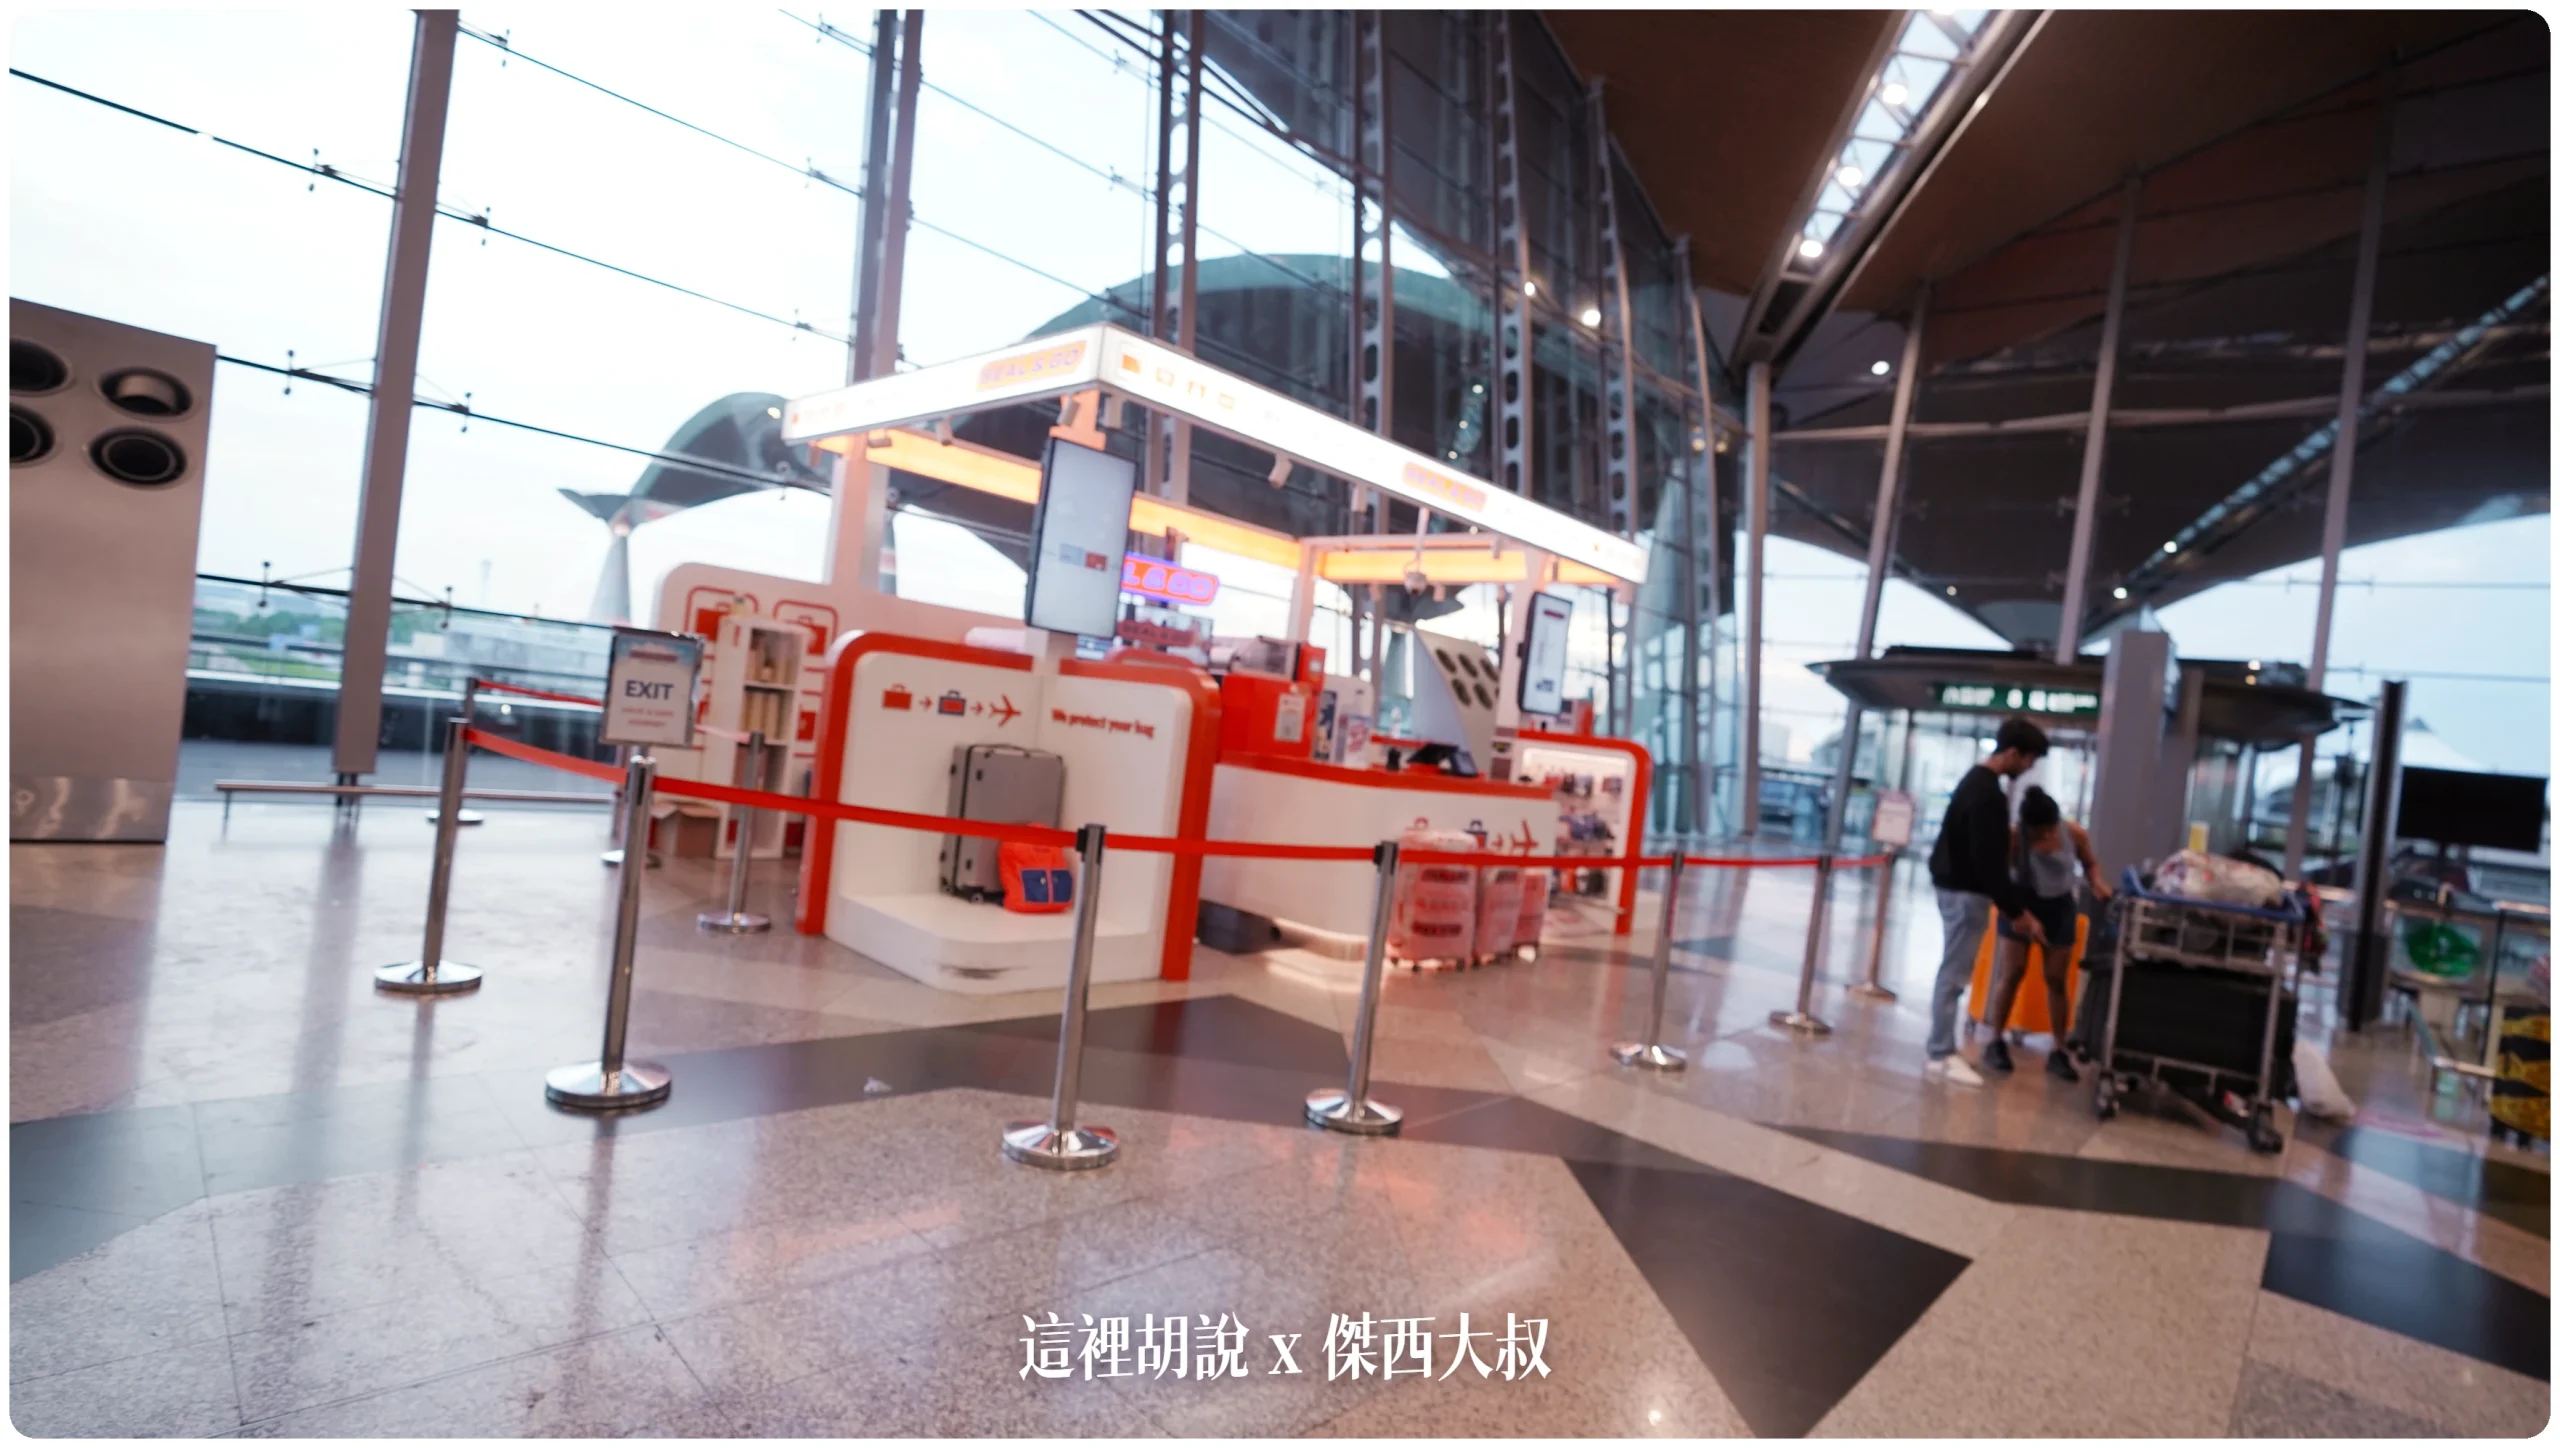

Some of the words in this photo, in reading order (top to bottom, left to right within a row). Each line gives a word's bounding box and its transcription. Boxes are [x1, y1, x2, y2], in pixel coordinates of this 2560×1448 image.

[625, 679, 674, 700] EXIT
[1069, 715, 1106, 729] protect
[1135, 720, 1154, 739] bag
